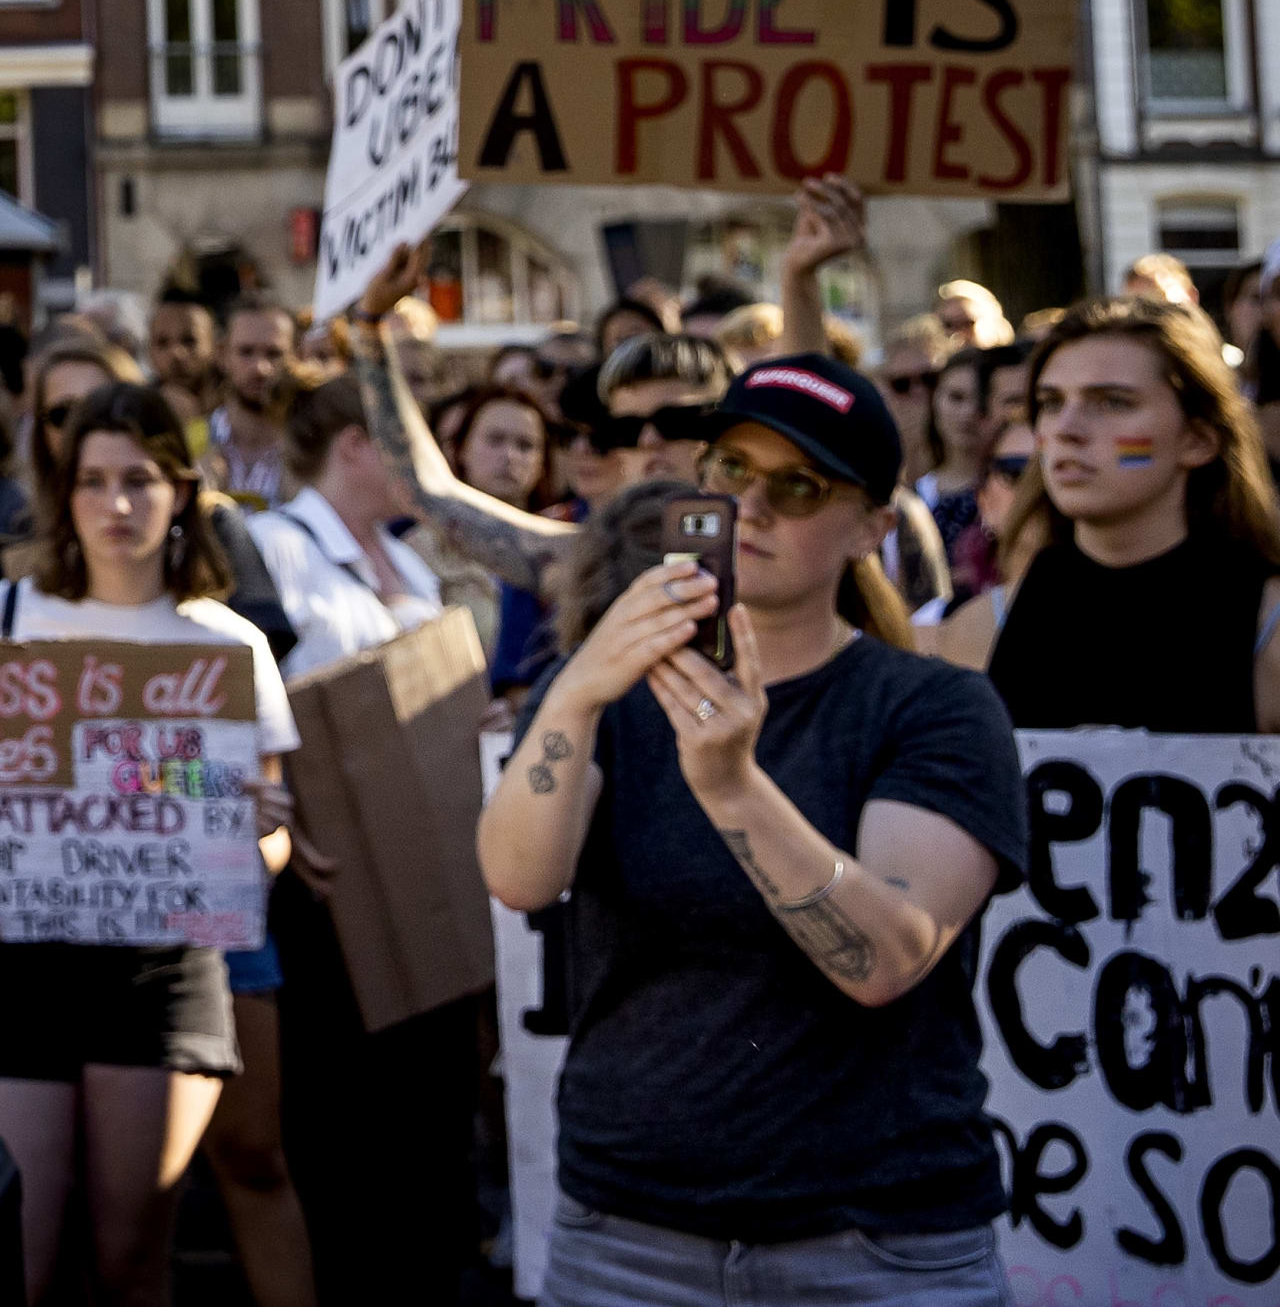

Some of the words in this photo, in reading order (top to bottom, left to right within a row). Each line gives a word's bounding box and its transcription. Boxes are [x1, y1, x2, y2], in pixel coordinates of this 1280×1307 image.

[476, 60, 569, 173] A
[614, 55, 1074, 191] PROTEST
[78, 654, 126, 715] is
[142, 656, 228, 717] all
[61, 837, 194, 879] DRIVER
